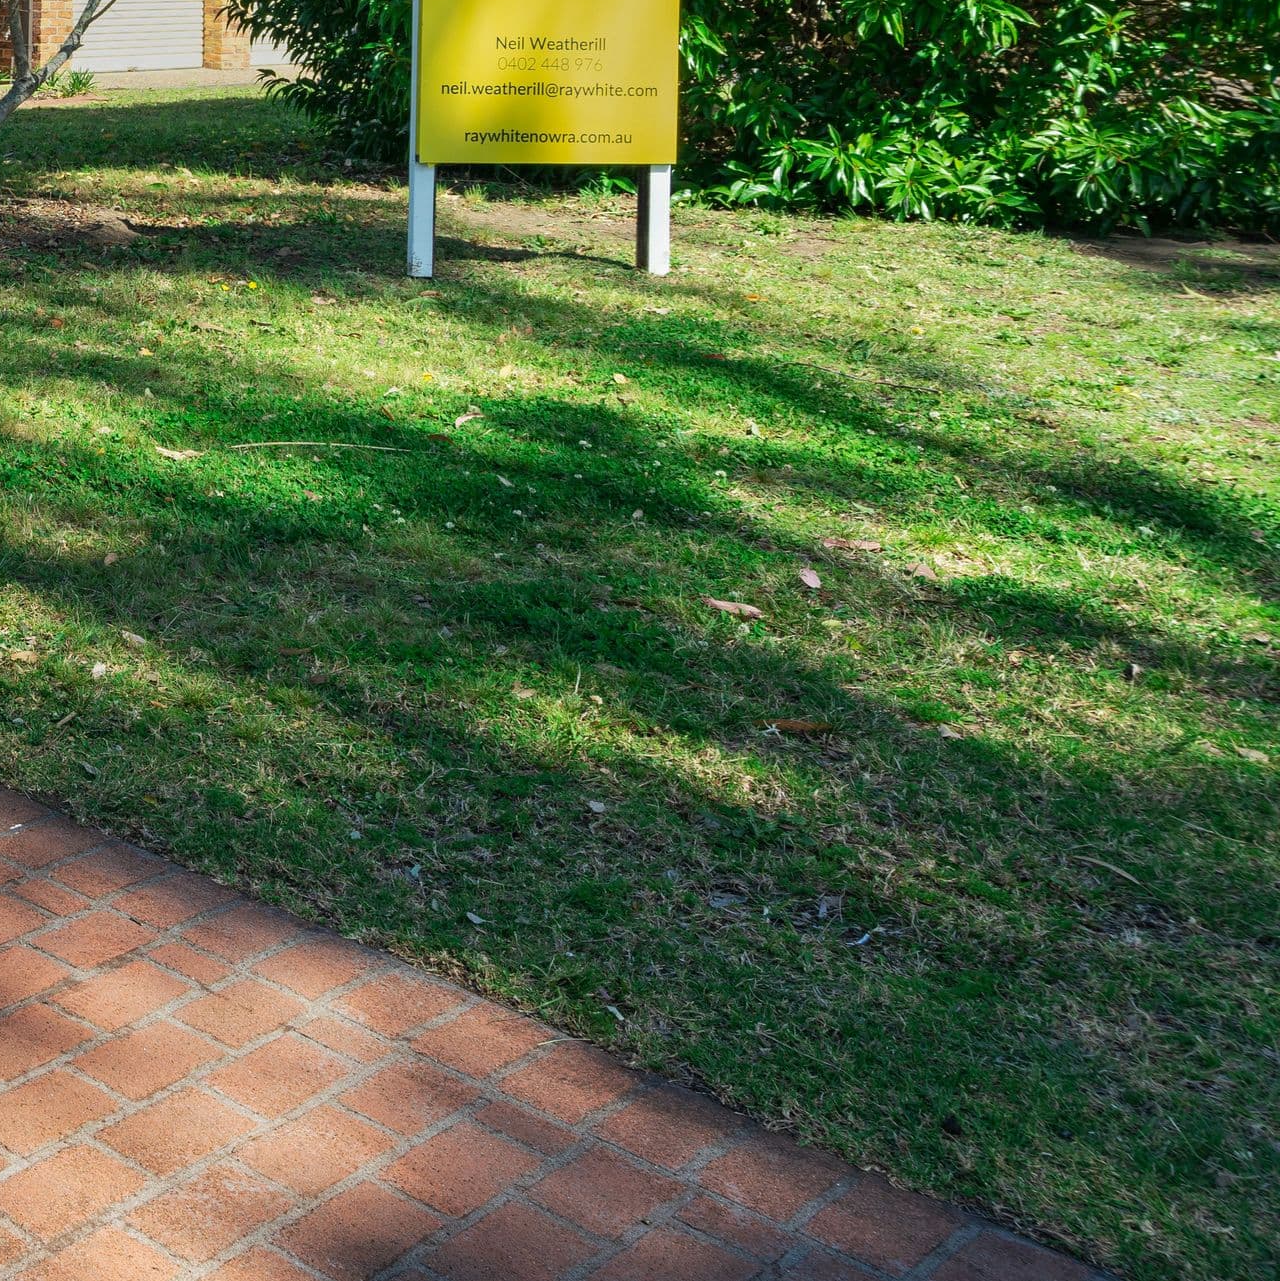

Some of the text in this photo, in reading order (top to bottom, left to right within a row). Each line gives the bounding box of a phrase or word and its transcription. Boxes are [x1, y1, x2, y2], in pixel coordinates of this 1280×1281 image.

[495, 36, 606, 51] Neil Weatherill
[497, 56, 603, 72] 0402 448 976
[441, 81, 658, 99] neil.weatherill@raywhite.com
[464, 129, 632, 144] raywhitenowra.com.au
